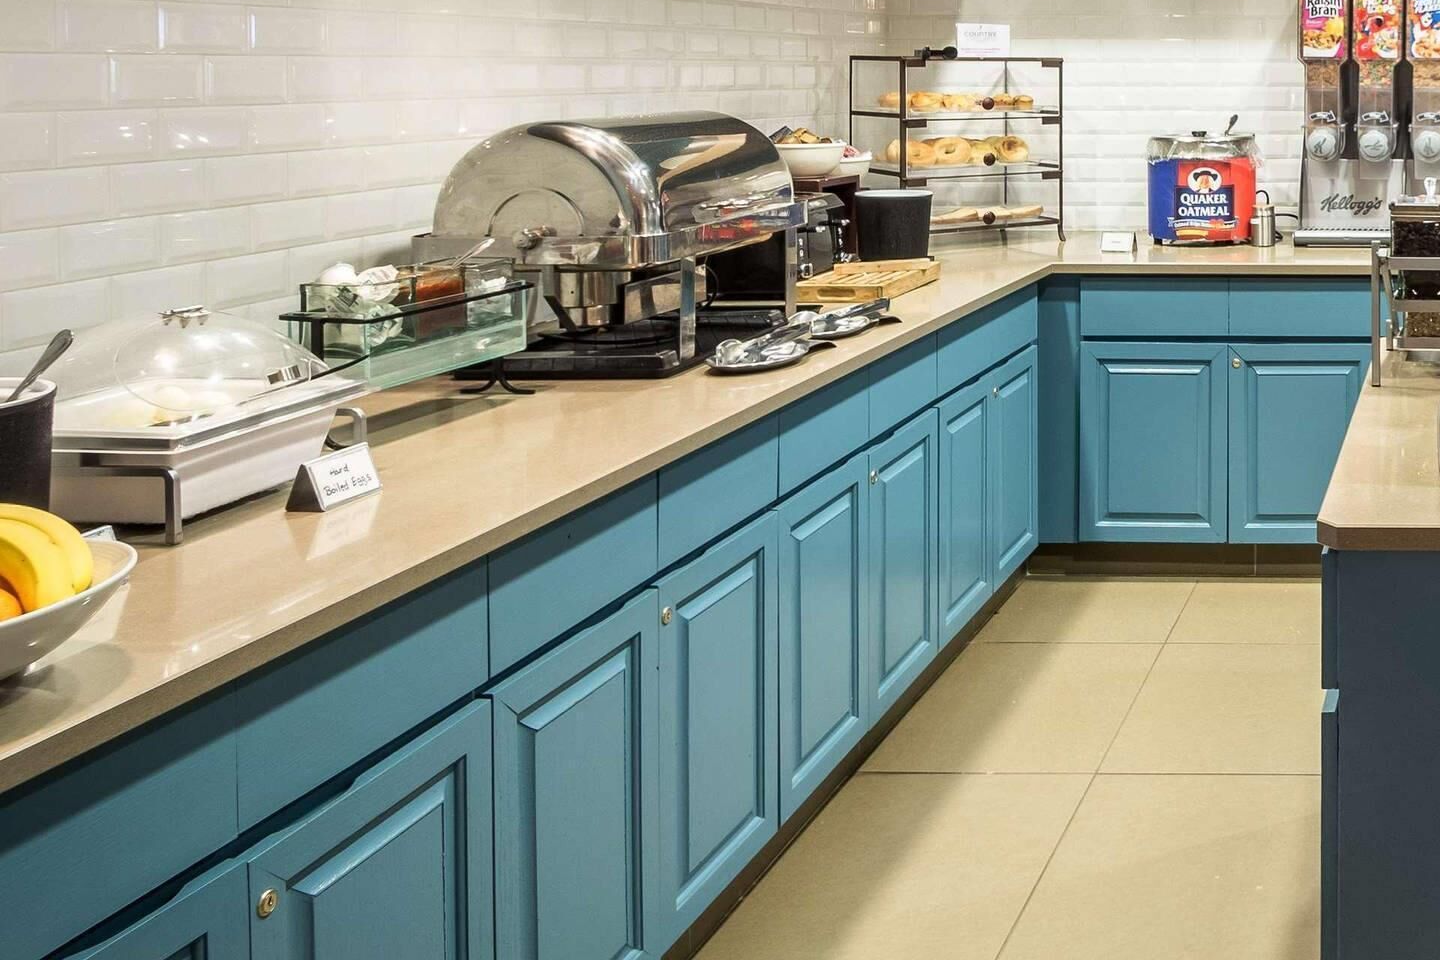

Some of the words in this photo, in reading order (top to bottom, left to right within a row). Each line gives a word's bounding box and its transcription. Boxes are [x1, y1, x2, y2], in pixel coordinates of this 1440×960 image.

[1310, 5, 1338, 17] Bran
[1180, 193, 1228, 206] QUAKER
[1320, 193, 1382, 215] Kellogg's
[1178, 206, 1230, 217] OATMEAL
[323, 482, 350, 497] Boiled
[351, 473, 372, 487] Eggs
